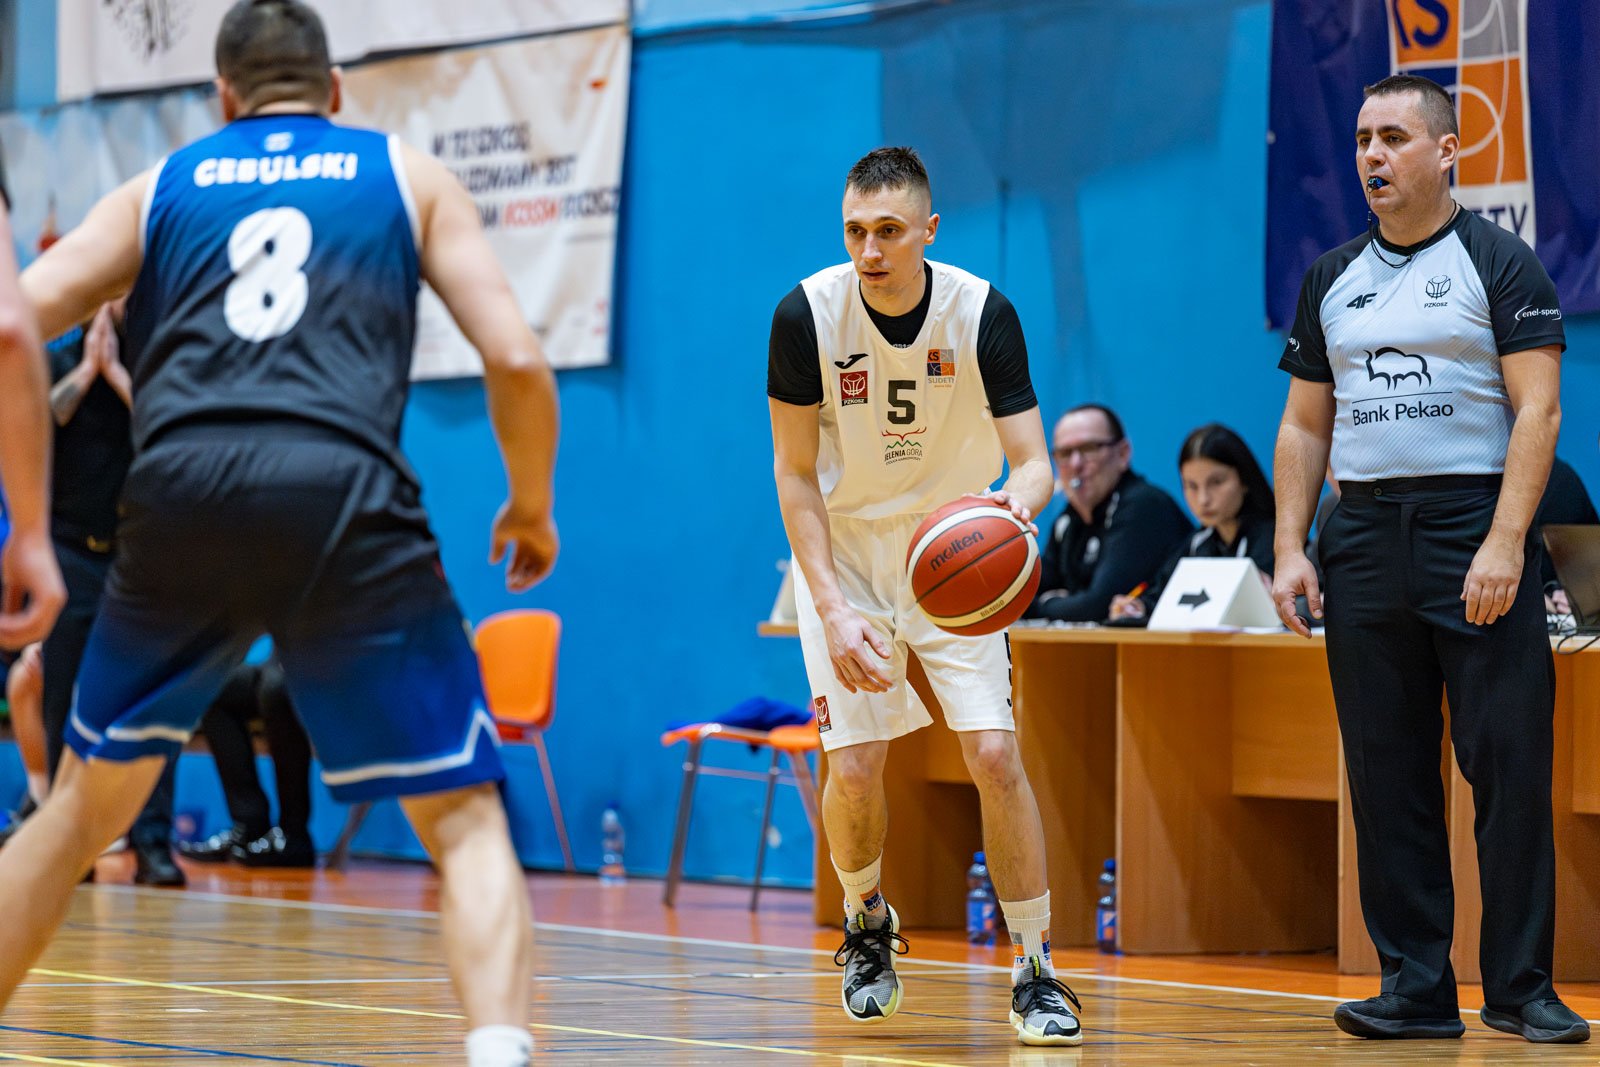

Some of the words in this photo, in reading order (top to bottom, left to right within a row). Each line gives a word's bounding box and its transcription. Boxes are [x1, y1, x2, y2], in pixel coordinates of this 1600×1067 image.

[193, 152, 358, 188] CEBULSKI
[223, 206, 313, 344] 8
[1346, 292, 1378, 309] 4F
[888, 380, 916, 424] 5
[1352, 405, 1390, 426] Bank
[1395, 401, 1454, 420] Pekao
[929, 530, 985, 572] molten
